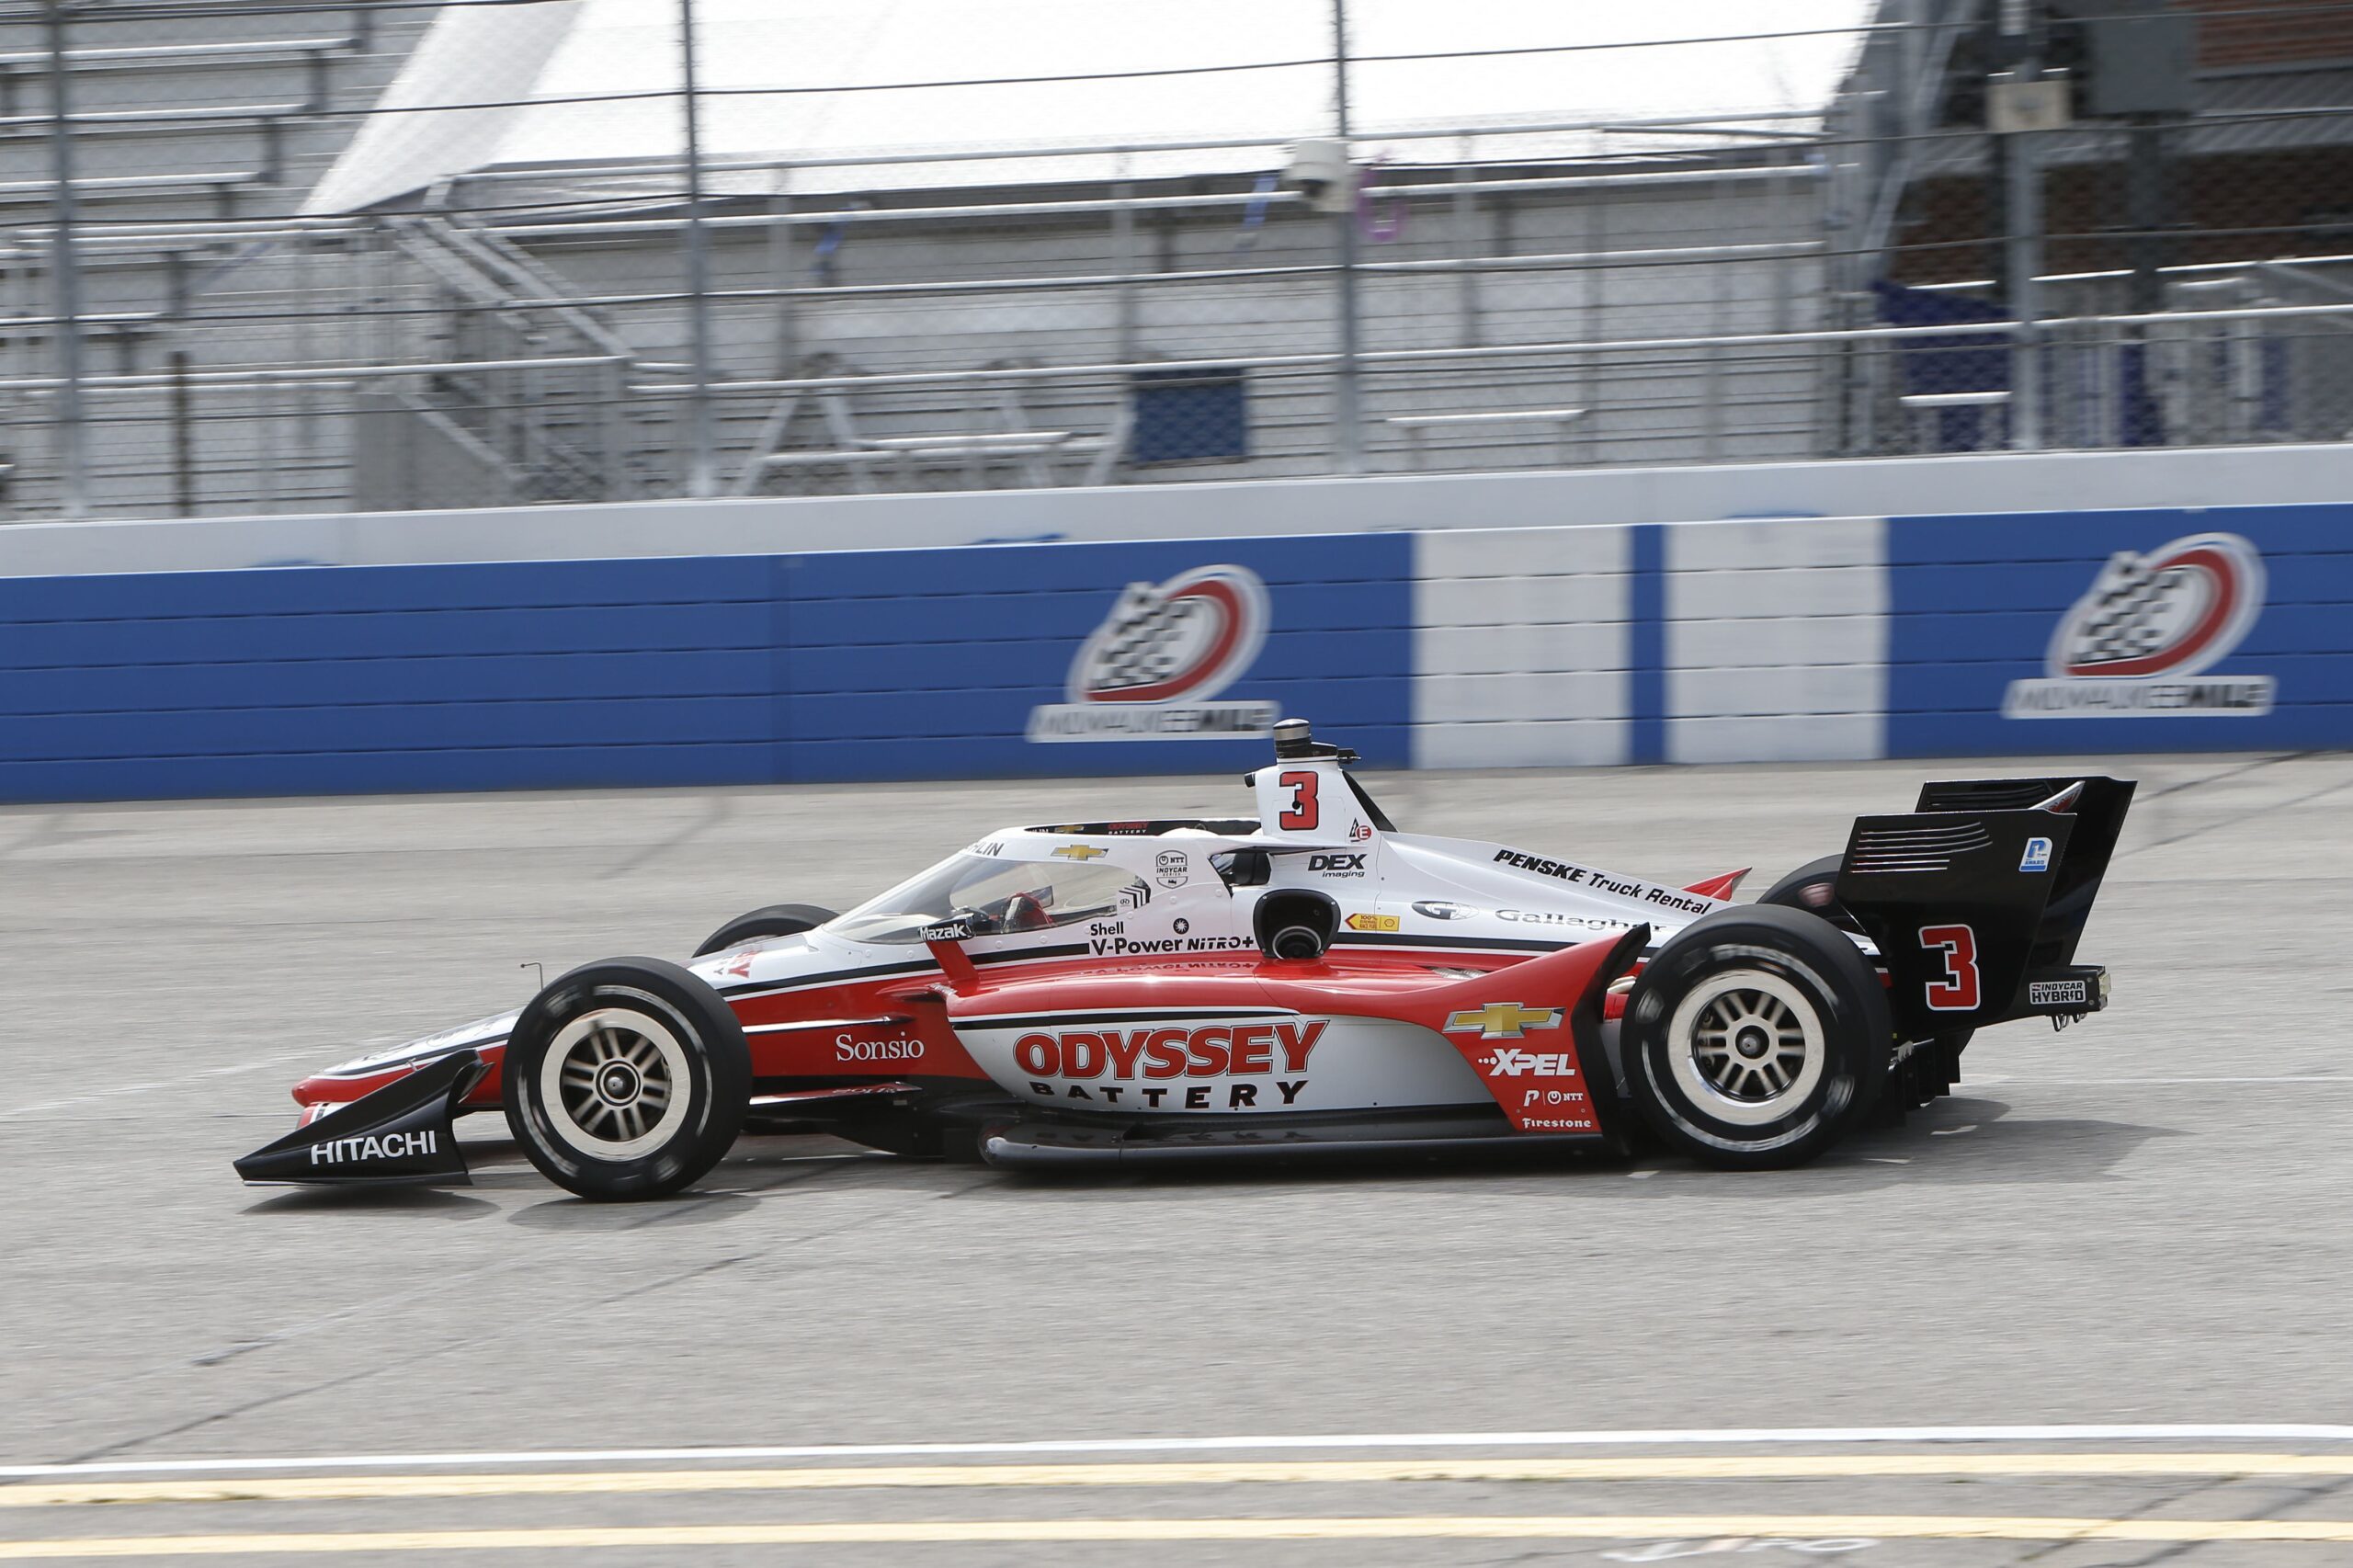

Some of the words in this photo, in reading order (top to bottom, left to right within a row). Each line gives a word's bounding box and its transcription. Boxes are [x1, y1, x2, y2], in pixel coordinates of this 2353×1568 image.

[1279, 770, 1319, 831] 3
[1308, 854, 1368, 871] DEX
[1322, 869, 1365, 879] imaging
[1493, 849, 1586, 882] PENSKE
[1588, 872, 1643, 898] Truck
[1645, 888, 1711, 915] Rental
[919, 924, 967, 941] Mazak
[1090, 921, 1124, 936] Shell
[1090, 937, 1183, 956] V-Power
[1918, 924, 1981, 1011] 3
[2041, 983, 2083, 992] INDYCAR
[835, 1031, 925, 1062] Sonsio
[1013, 1020, 1330, 1080] ODYSSEY
[1488, 1048, 1575, 1076] XPEL
[1029, 1081, 1308, 1109] BATTERY
[1563, 1093, 1584, 1101] NTT
[1522, 1118, 1592, 1129] Firestone
[311, 1130, 438, 1165] HITACHI
